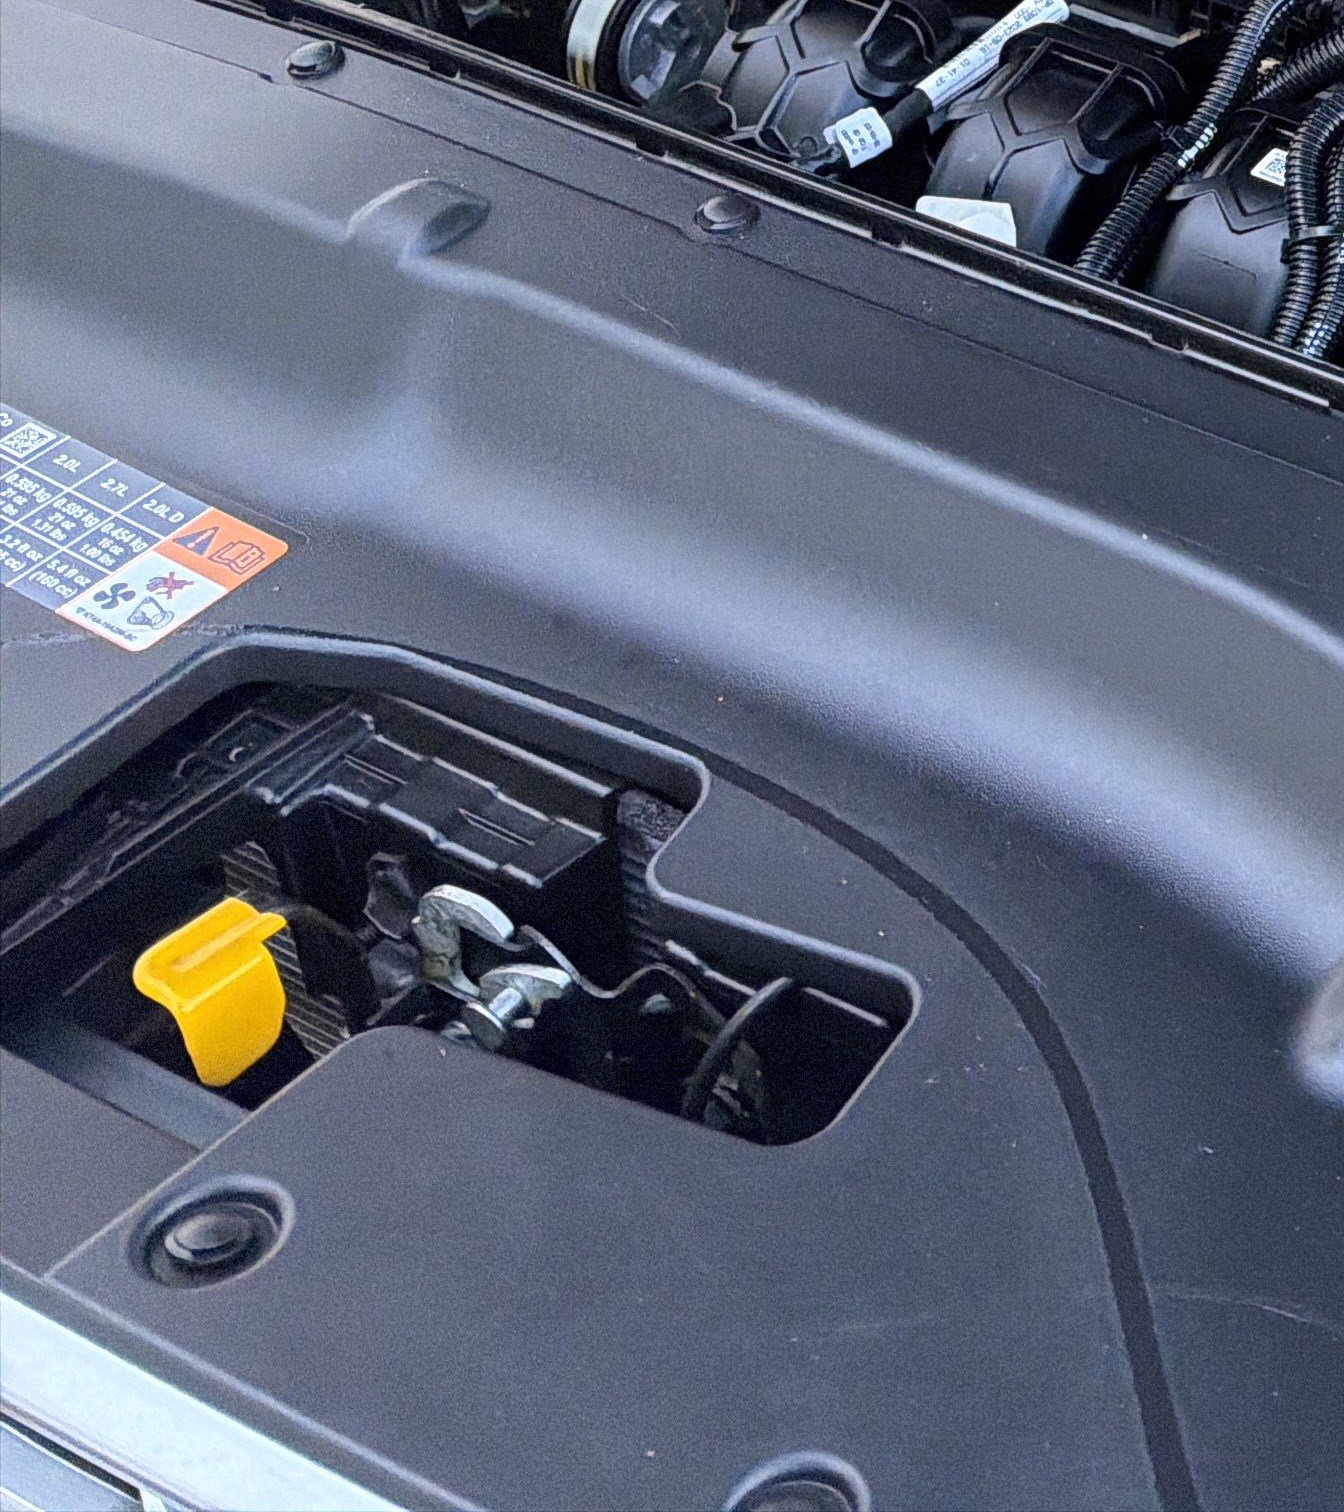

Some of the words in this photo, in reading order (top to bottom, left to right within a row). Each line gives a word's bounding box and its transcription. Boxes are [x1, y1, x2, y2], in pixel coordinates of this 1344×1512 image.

[53, 454, 82, 473] 2.0L
[100, 478, 129, 497] 2.7L
[81, 512, 101, 528] kg
[129, 536, 149, 553] kg
